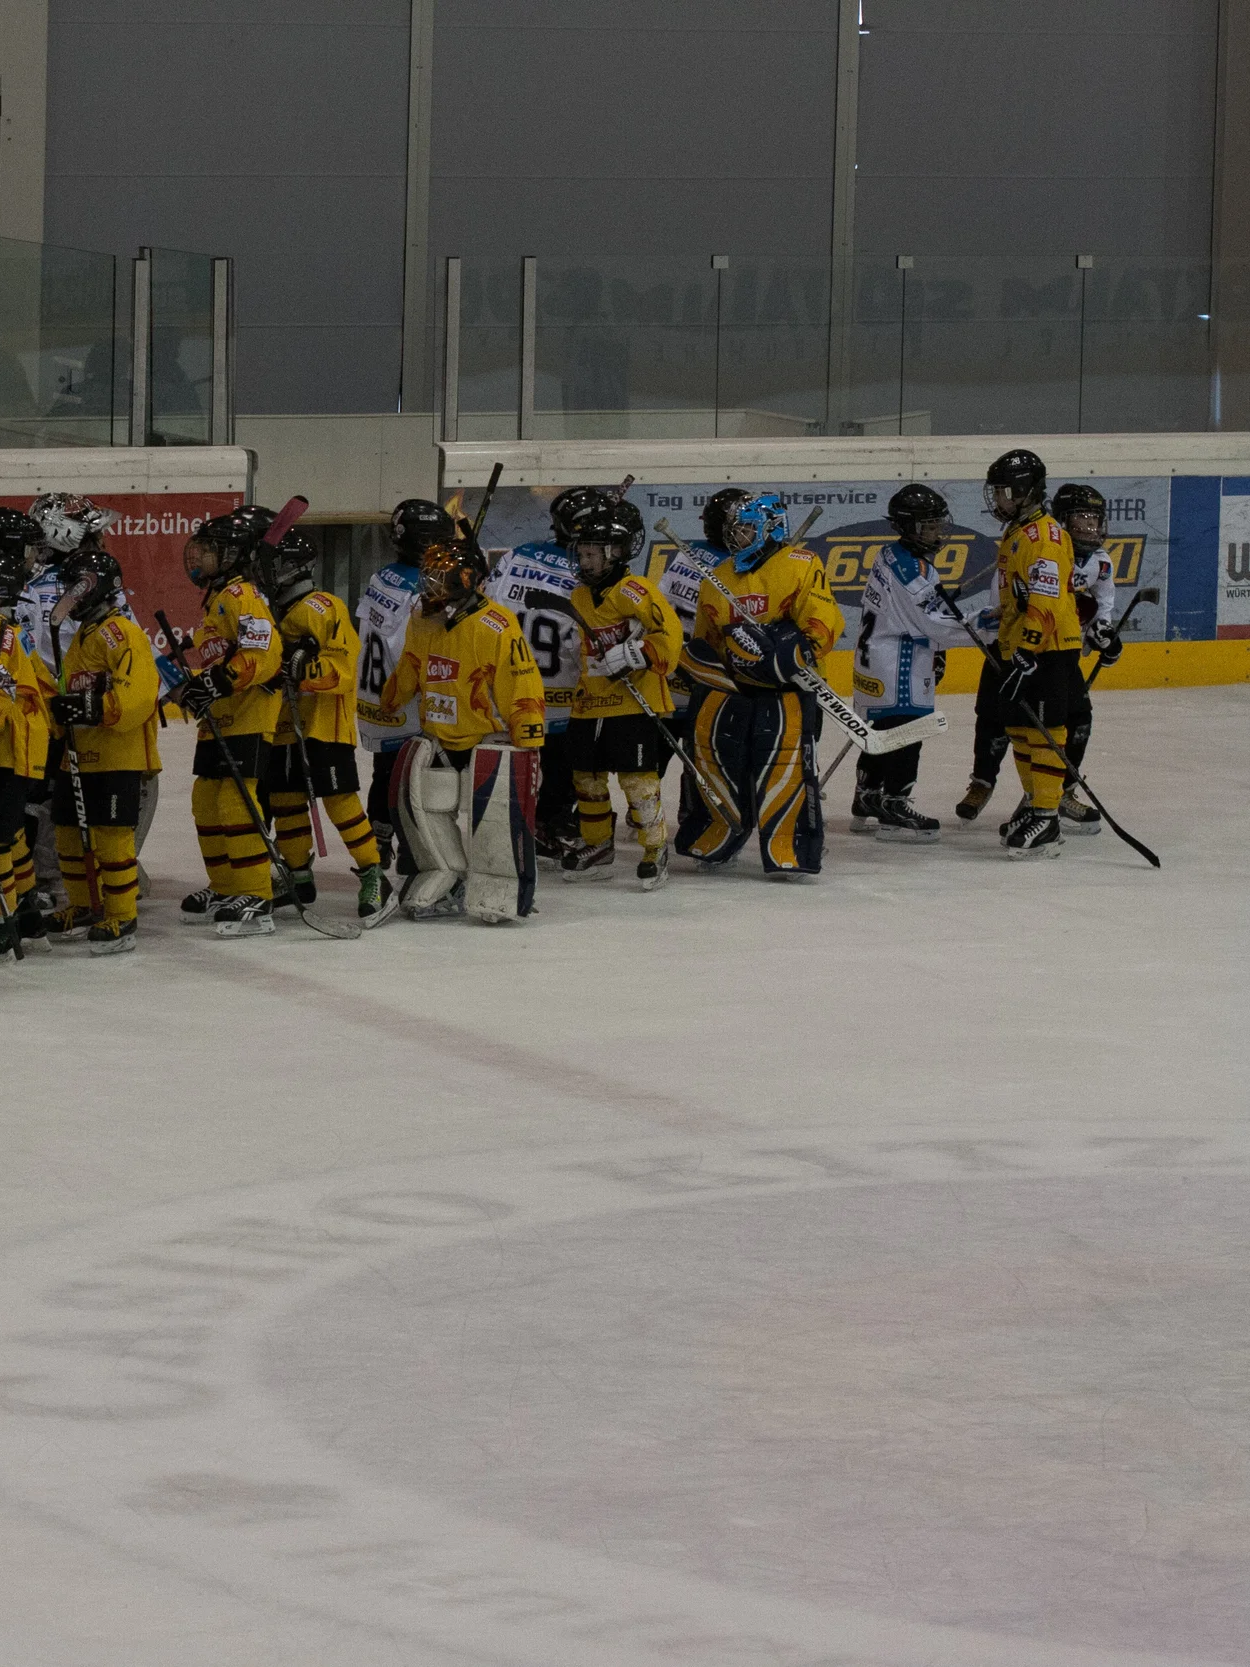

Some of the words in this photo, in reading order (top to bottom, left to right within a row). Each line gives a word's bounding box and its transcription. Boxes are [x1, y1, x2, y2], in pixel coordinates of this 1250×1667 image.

[647, 493, 683, 510] Tag
[510, 565, 579, 591] LIWES
[481, 616, 503, 633] RICOH
[67, 749, 88, 829] EASTON
